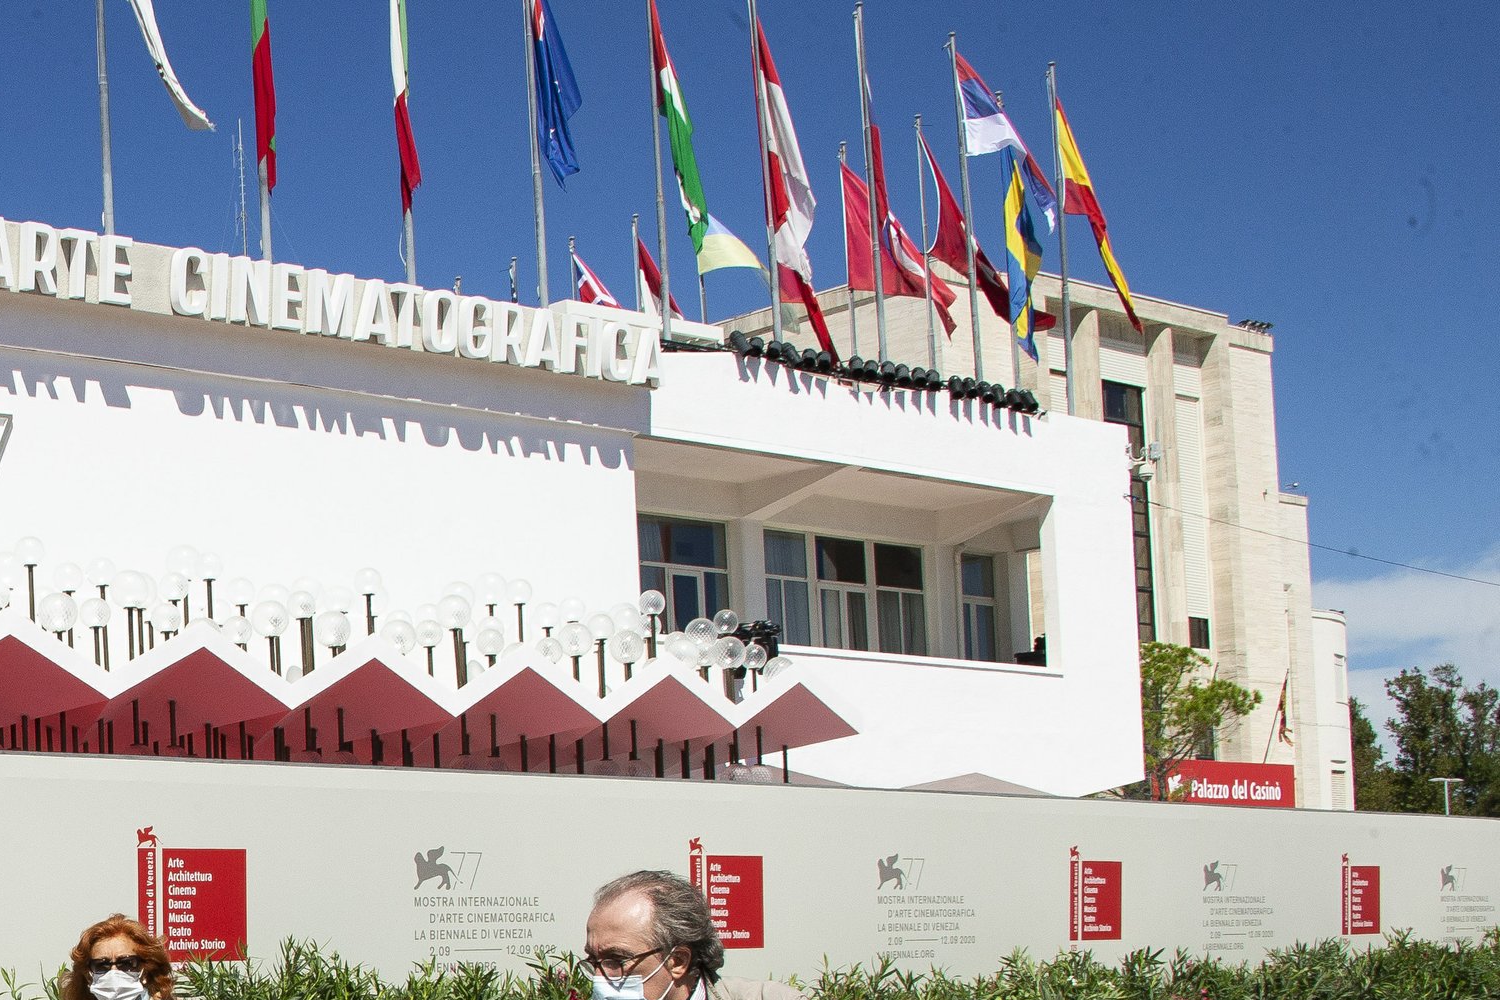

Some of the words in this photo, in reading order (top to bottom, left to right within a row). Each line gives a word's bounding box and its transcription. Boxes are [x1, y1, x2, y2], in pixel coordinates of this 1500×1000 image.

[169, 247, 665, 388] CINEMATOGRAFICA
[1191, 778, 1229, 799] Palazzo
[1232, 779, 1248, 799] del
[1250, 780, 1282, 801] Casinò
[146, 851, 154, 886] Venezia
[168, 858, 184, 868] Arte
[168, 870, 213, 882] Architettura
[450, 851, 483, 890] 77
[146, 889, 154, 897] di
[168, 884, 197, 896] Cinema
[168, 899, 192, 910] Danza
[414, 897, 454, 907] MOSTRA
[458, 896, 539, 907] INTERNAZIONALE
[877, 896, 906, 904] MOSTRA
[908, 895, 964, 904] INTERNAZIONALE
[168, 912, 195, 923] Musica
[429, 913, 464, 924] D'ARTE
[467, 912, 555, 923] CINEMATOGRAFICA
[913, 909, 975, 918] CINEMATOGRAFICA
[168, 926, 192, 937] Teatro
[877, 923, 886, 932] LA
[888, 922, 921, 932] BIENNALE
[932, 922, 959, 931] VENEZIA
[414, 930, 426, 940] LA
[430, 929, 477, 940] BIENNALE
[481, 929, 490, 939] DI
[494, 929, 533, 939] VENEZIA
[169, 939, 199, 951] Archivio
[201, 939, 226, 950] Storico
[429, 946, 451, 957] 2.09
[506, 944, 531, 955] 12.09
